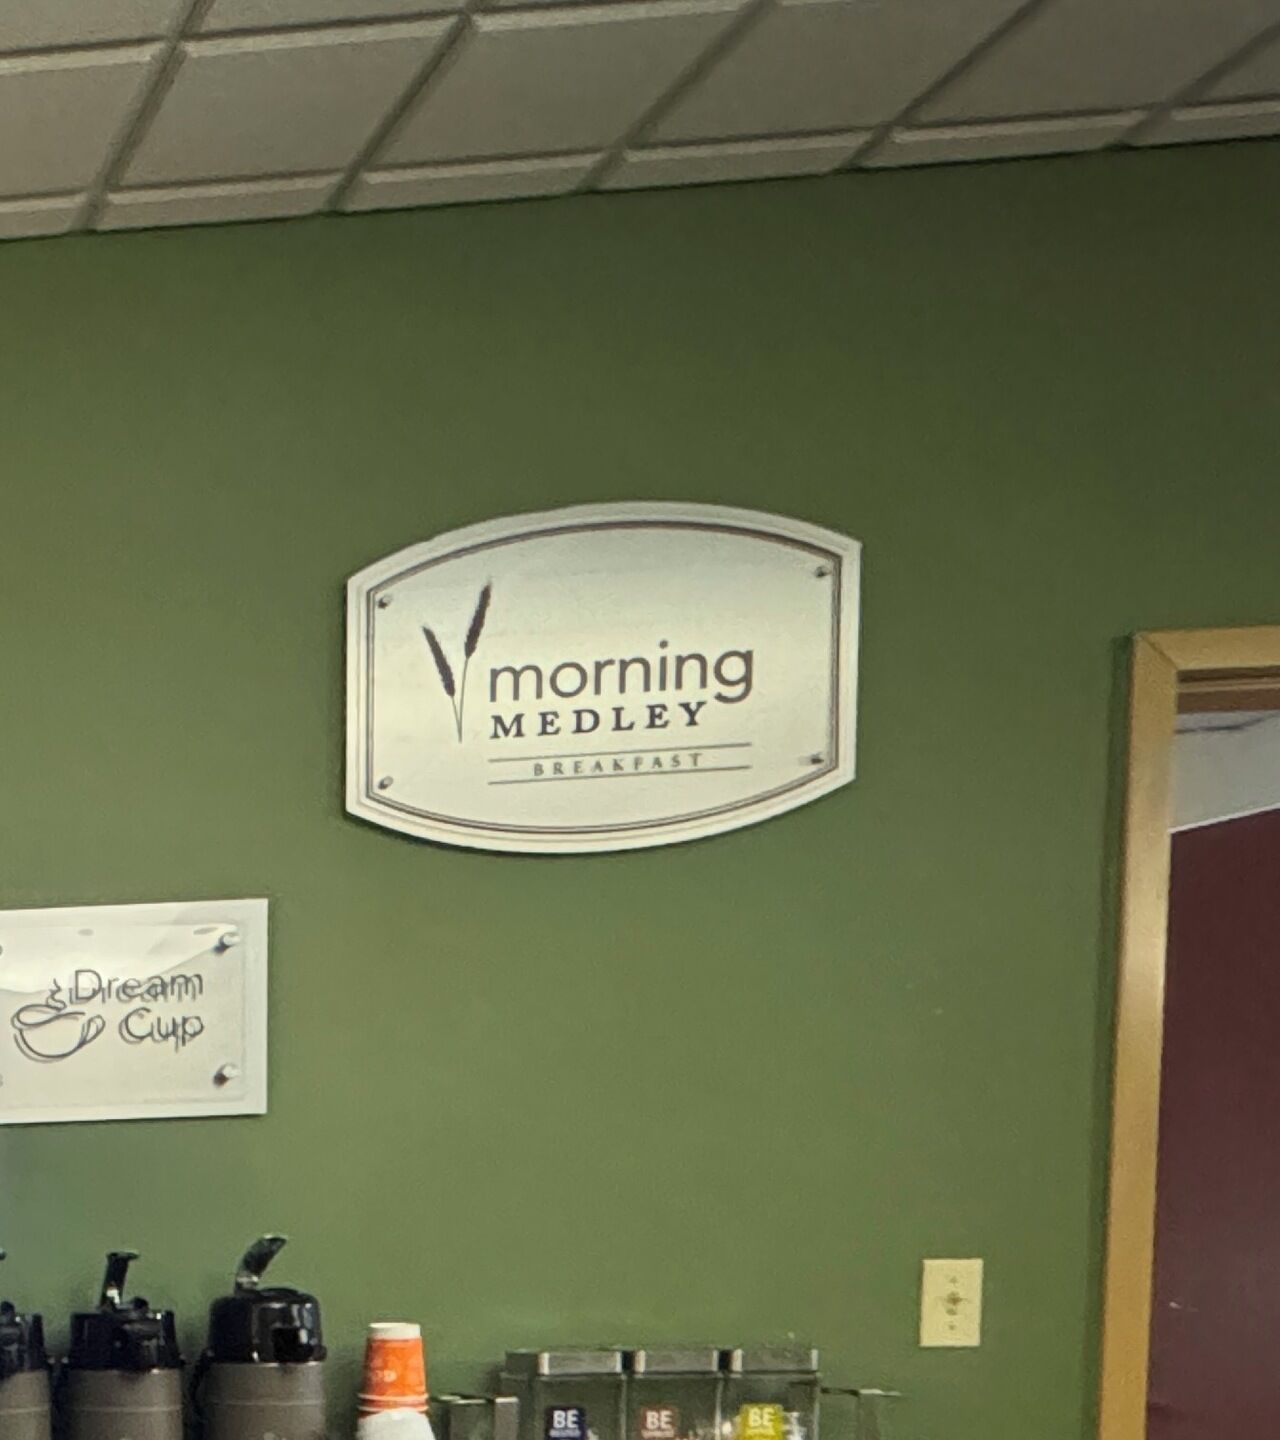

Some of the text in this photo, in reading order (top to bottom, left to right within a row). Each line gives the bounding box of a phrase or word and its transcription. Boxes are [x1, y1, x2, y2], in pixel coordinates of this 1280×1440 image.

[489, 640, 754, 703] morning
[489, 700, 709, 740] MEDLEY
[533, 752, 703, 777] BREAKFAST
[73, 968, 204, 1002] Dream
[123, 1006, 204, 1048] Cup
[553, 1408, 579, 1429] BE
[646, 1410, 673, 1430] BE
[748, 1407, 775, 1427] BE
